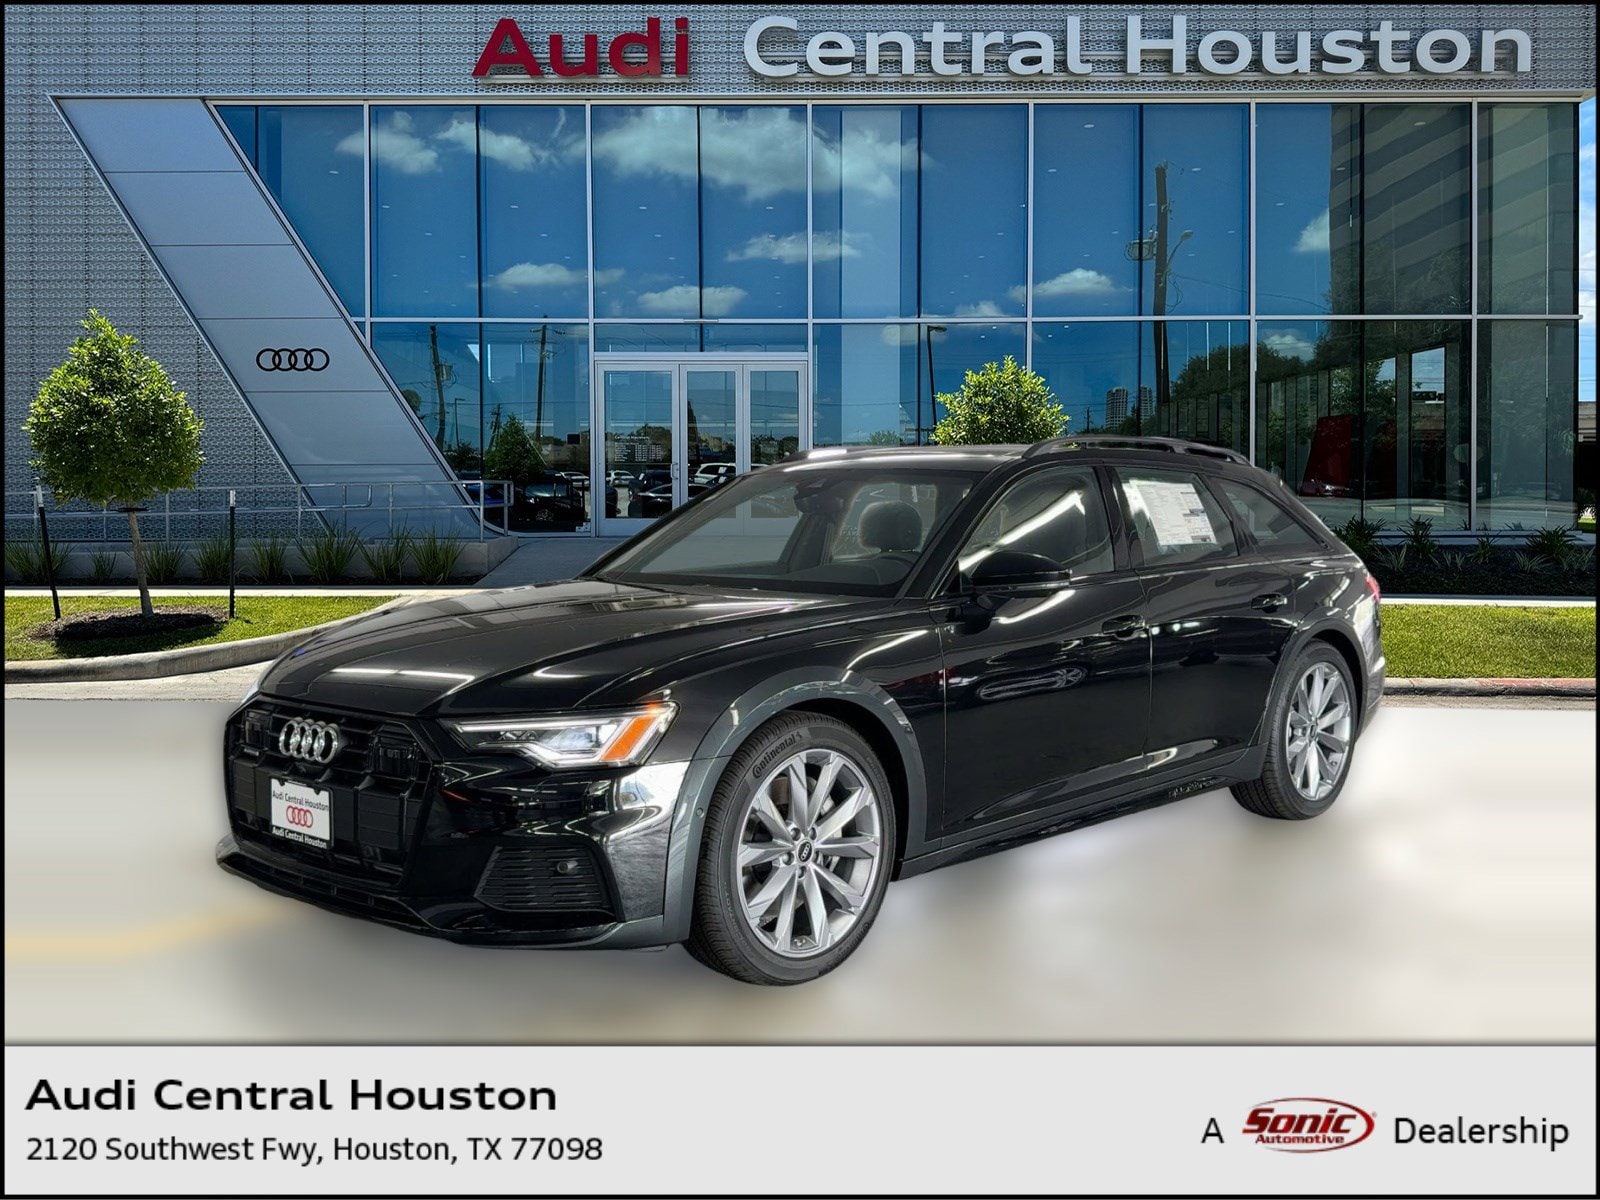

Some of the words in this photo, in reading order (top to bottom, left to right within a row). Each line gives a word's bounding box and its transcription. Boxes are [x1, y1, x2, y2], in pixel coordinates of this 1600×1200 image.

[472, 17, 690, 77] Audi
[743, 15, 1098, 76] Central
[1126, 15, 1533, 76] Houston
[752, 733, 797, 778] Continental
[272, 790, 284, 800] Audi
[285, 793, 304, 805] Central
[305, 798, 329, 811] Houston
[272, 826, 285, 836] Audi
[285, 830, 304, 842] Central
[305, 835, 327, 849] Houston
